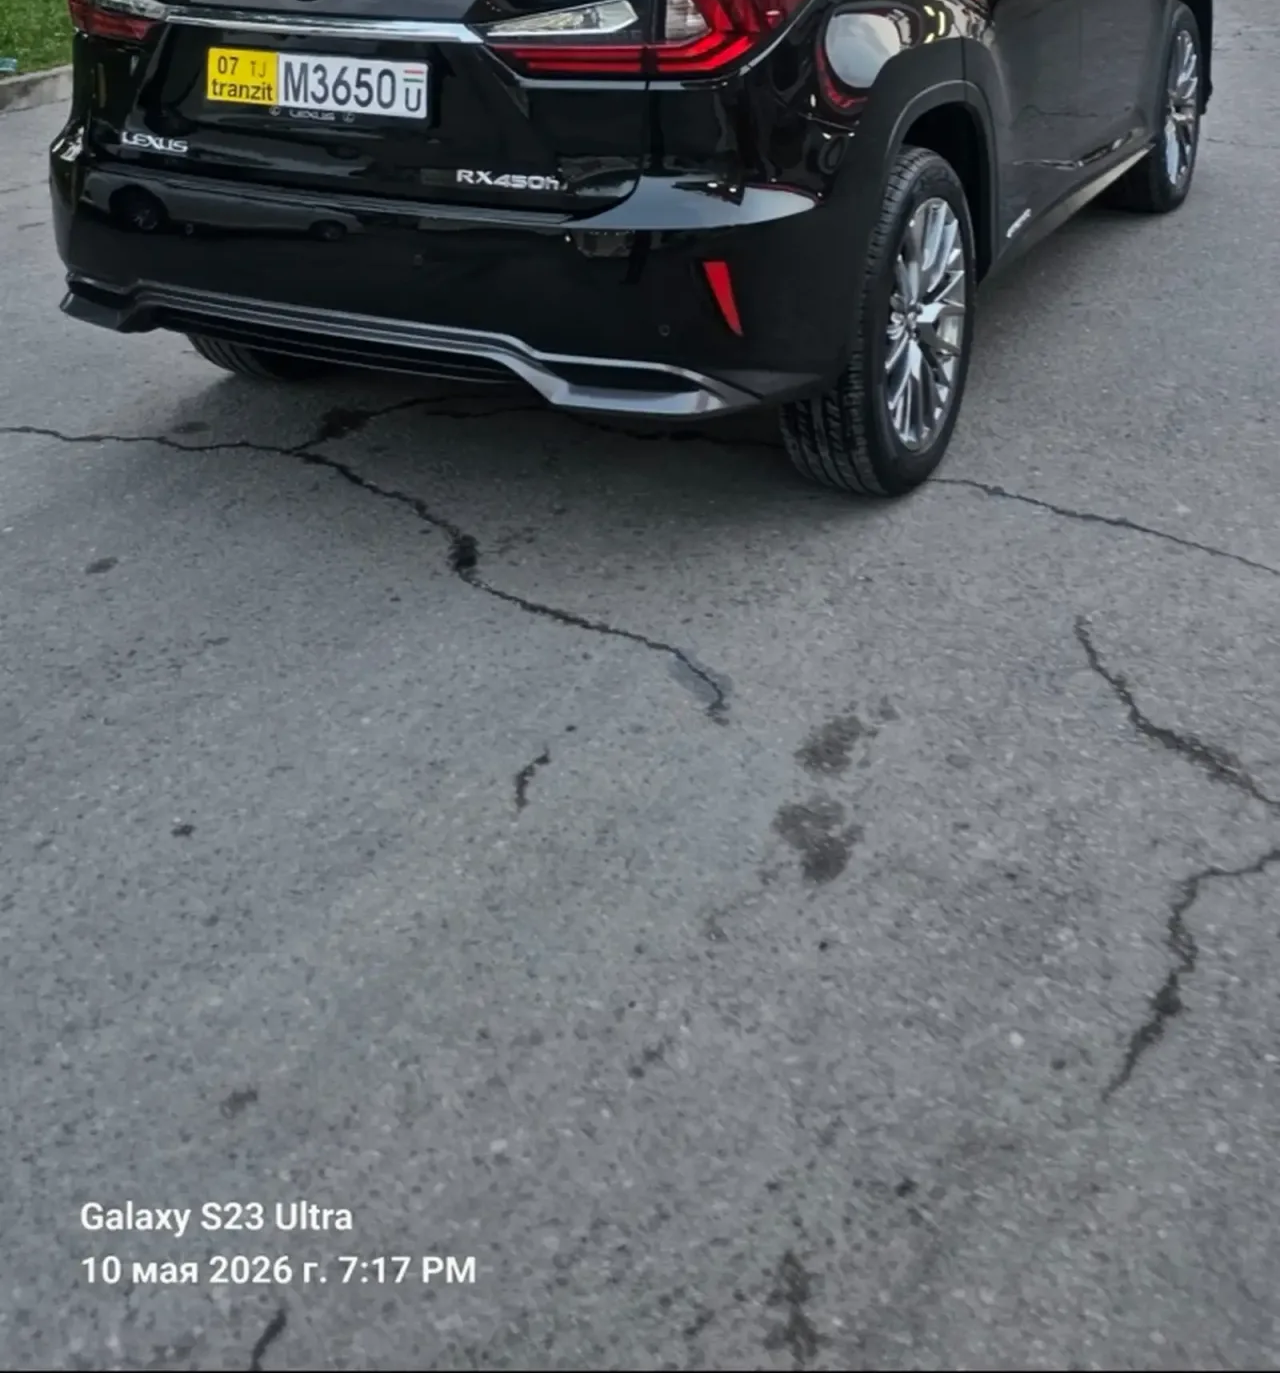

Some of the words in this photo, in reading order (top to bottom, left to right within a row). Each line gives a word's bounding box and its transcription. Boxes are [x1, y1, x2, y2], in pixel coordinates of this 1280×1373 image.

[217, 56, 240, 75] 07
[211, 77, 274, 101] tranzit
[283, 60, 397, 110] M3650
[404, 87, 423, 112] U
[121, 131, 189, 153] LEXUS
